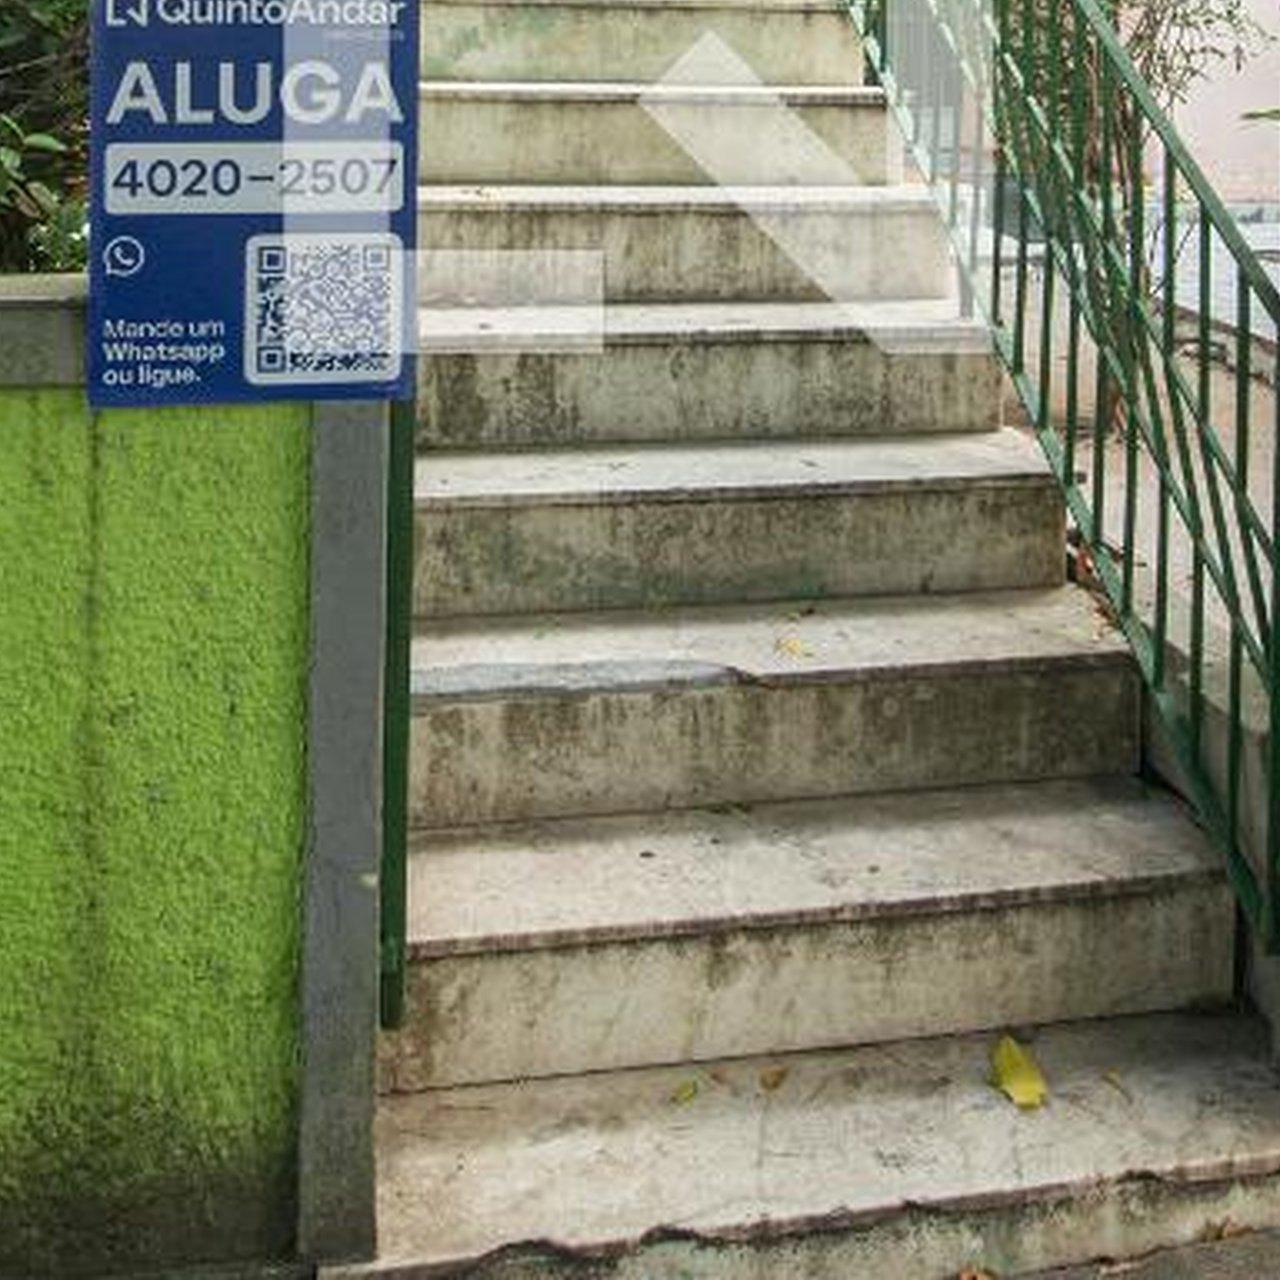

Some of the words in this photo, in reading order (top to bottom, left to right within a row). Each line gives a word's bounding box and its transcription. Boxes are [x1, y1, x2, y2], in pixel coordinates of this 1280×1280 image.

[106, 61, 405, 125] ALUGA
[112, 158, 398, 197] 4020-2507
[188, 321, 225, 337] um
[102, 369, 133, 385] ou
[138, 363, 200, 388] ligue.
